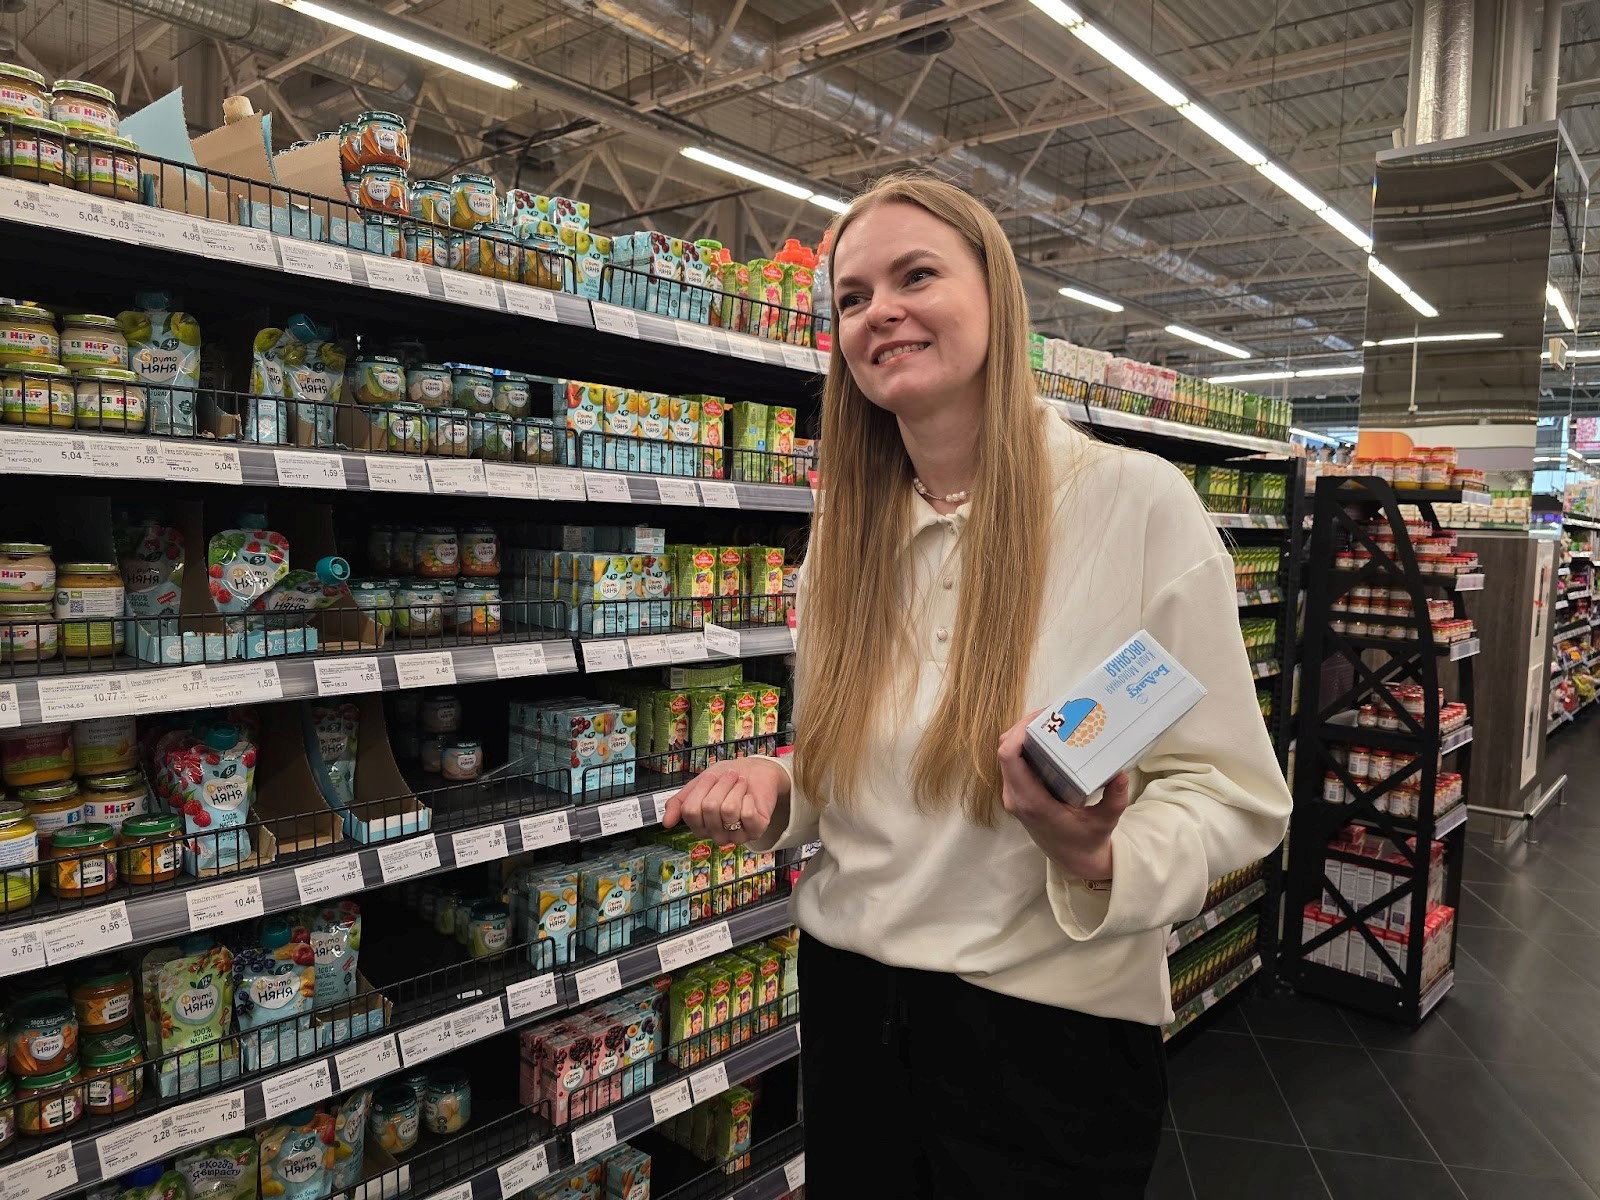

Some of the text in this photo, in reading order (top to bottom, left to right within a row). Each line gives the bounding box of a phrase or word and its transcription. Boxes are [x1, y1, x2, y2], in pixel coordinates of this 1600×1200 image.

[2, 90, 27, 101] HiPP
[84, 108, 107, 120] HiPP
[14, 200, 35, 210] 4,99
[473, 200, 490, 209] НЯНЯ
[79, 212, 99, 223] 5,04
[110, 218, 130, 230] 5,03
[182, 231, 200, 241] 4,99
[249, 242, 265, 252] 1,65
[10, 331, 35, 340] HiPP
[85, 342, 108, 350] HiPP
[141, 362, 177, 374] НЯНЯ
[16, 390, 42, 398] HiPP
[301, 384, 327, 394] НЯНЯ
[116, 397, 137, 405] HPP
[61, 451, 82, 460] 5,04
[136, 456, 155, 464] 5,59
[215, 462, 232, 470] 5,04
[273, 602, 305, 610] НЯНЯ
[1103, 639, 1146, 678] ОВСЯНАЯ
[183, 682, 200, 692] 9,77
[257, 679, 273, 688] 1,59
[94, 693, 117, 702] 10,77
[1048, 712, 1065, 733] 5+
[211, 790, 243, 805] НЯНЯ
[104, 802, 135, 814] HiPP
[72, 812, 78, 820] 8
[420, 851, 432, 860] 1,65
[342, 872, 356, 881] 1,65
[234, 896, 255, 907] 10,44
[100, 922, 120, 934] 9,56
[549, 919, 566, 928] НЯНЯ
[12, 945, 32, 957] 9,76
[258, 988, 293, 1002] НЯНЯ
[540, 988, 551, 998] 2,54
[109, 996, 128, 1007] Heinz
[184, 999, 215, 1016] НЯНЯ
[486, 1014, 498, 1023] 2,54
[193, 1026, 212, 1037] 100%
[438, 1031, 450, 1041] 2,54
[190, 1033, 214, 1044] NATURAL
[36, 1043, 60, 1054] НЯНЯ
[377, 1050, 391, 1062] 1,59
[309, 1080, 324, 1090] 1,65
[221, 1111, 238, 1121] 1,50
[153, 1130, 170, 1143] 2,28
[304, 1139, 314, 1147] 6+
[198, 1159, 233, 1171] #Когда
[284, 1162, 317, 1177] НЯНЯ
[47, 1164, 67, 1179] 2,28
